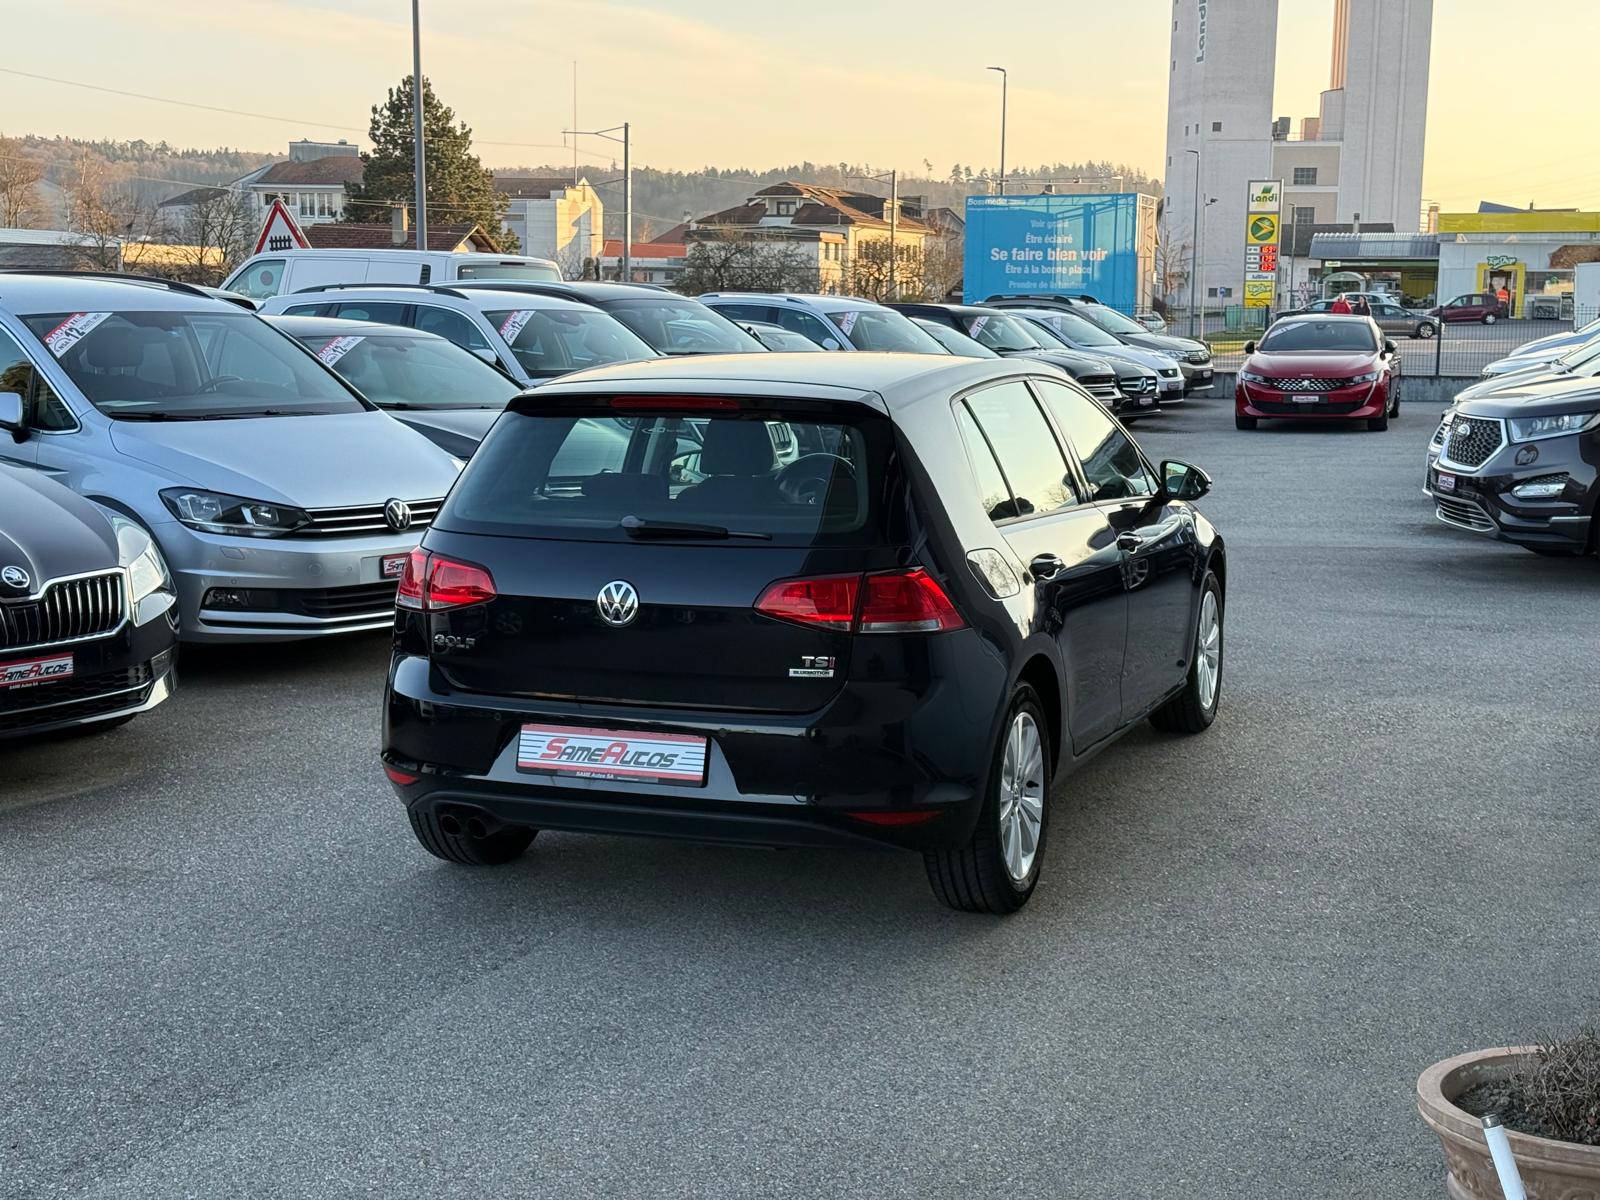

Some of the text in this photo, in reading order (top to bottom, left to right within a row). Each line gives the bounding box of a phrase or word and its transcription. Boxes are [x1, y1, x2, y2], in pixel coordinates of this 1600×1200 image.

[1251, 193, 1278, 203] Landi
[1025, 232, 1073, 243] Être éclairé
[990, 247, 1108, 261] Se faire bien voir
[1005, 262, 1022, 273] Être
[1023, 264, 1030, 273] à
[1031, 264, 1040, 273] la
[45, 313, 83, 344] GARANTIE
[64, 327, 86, 340] 12
[434, 634, 476, 649] GOLF
[801, 655, 836, 668] TSI
